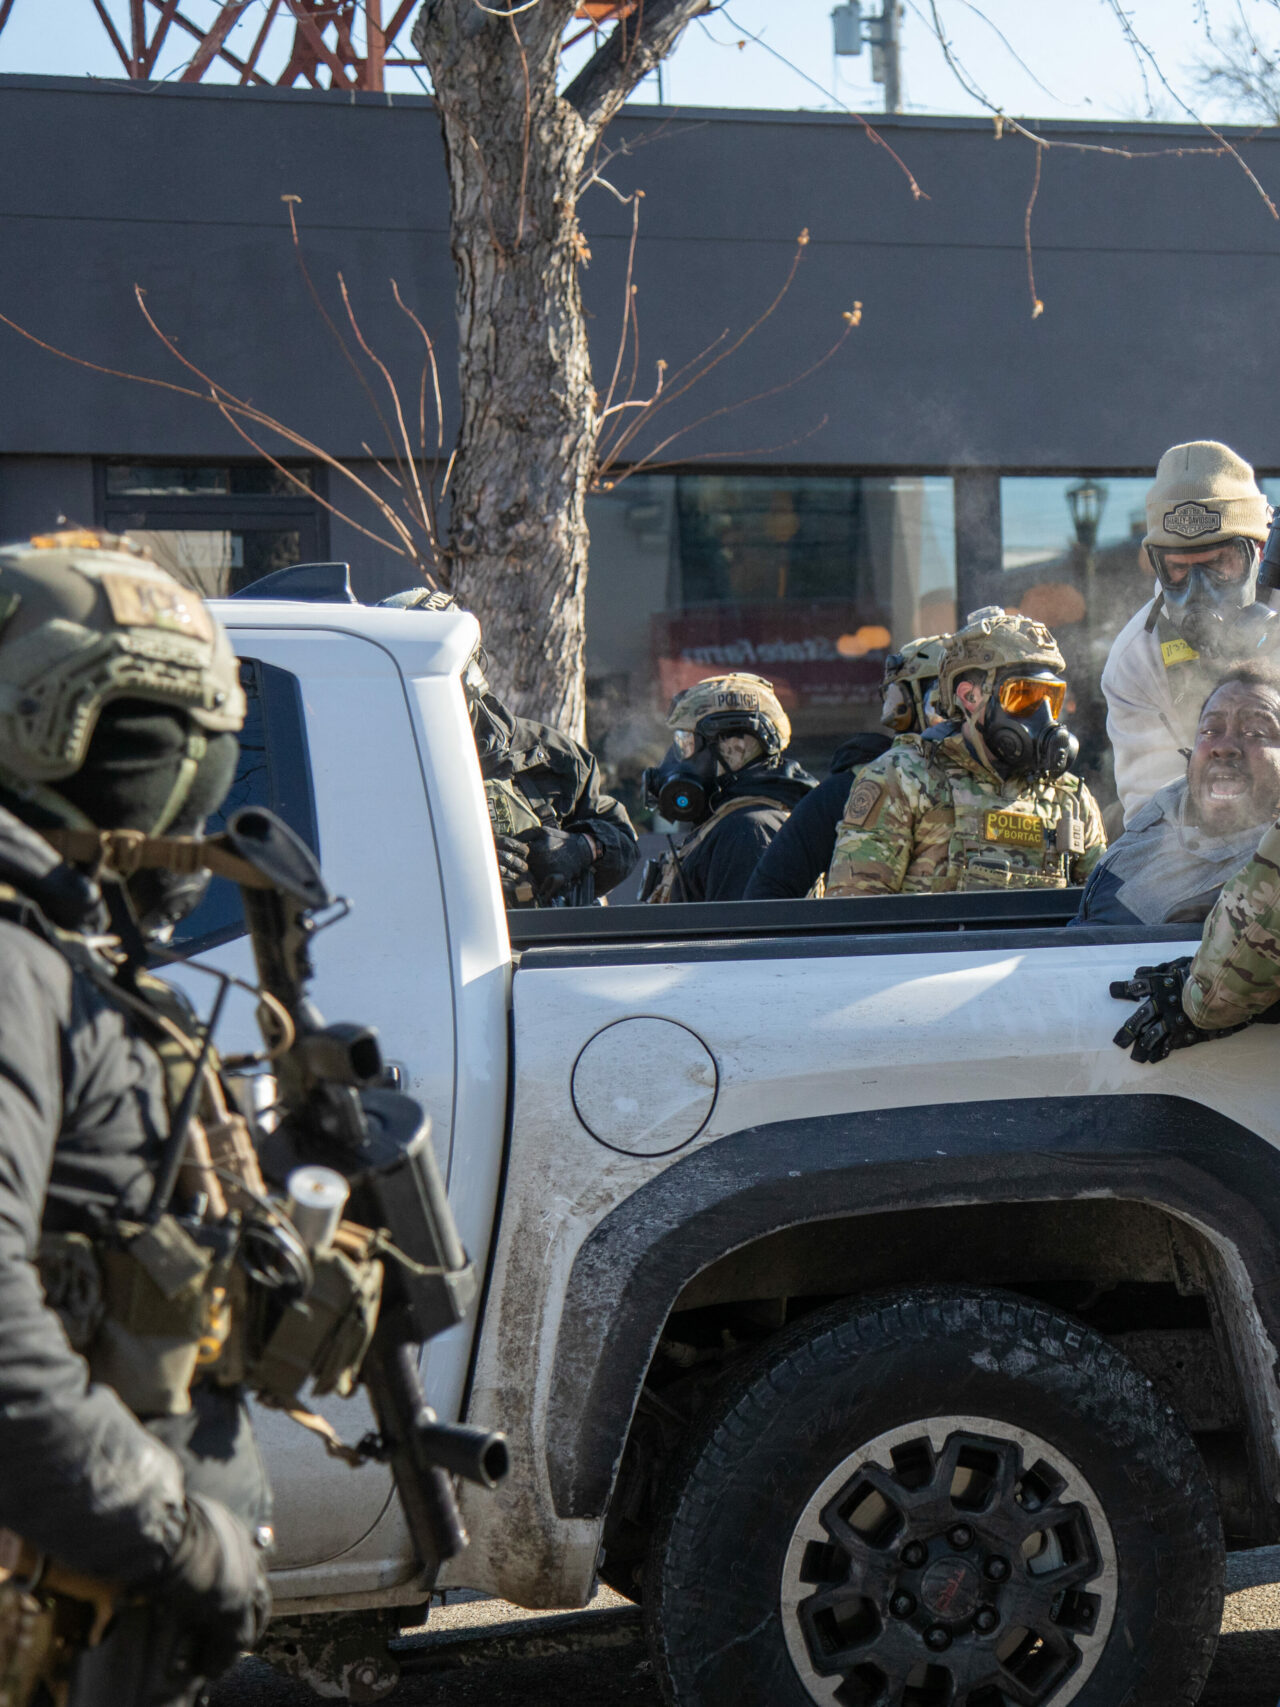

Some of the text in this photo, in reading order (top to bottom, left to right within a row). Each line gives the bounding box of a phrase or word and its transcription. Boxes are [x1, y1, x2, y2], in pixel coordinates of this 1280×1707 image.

[717, 692, 757, 708] POLICE
[987, 813, 1041, 832] POLICE
[1004, 829, 1041, 842] BORTAC
